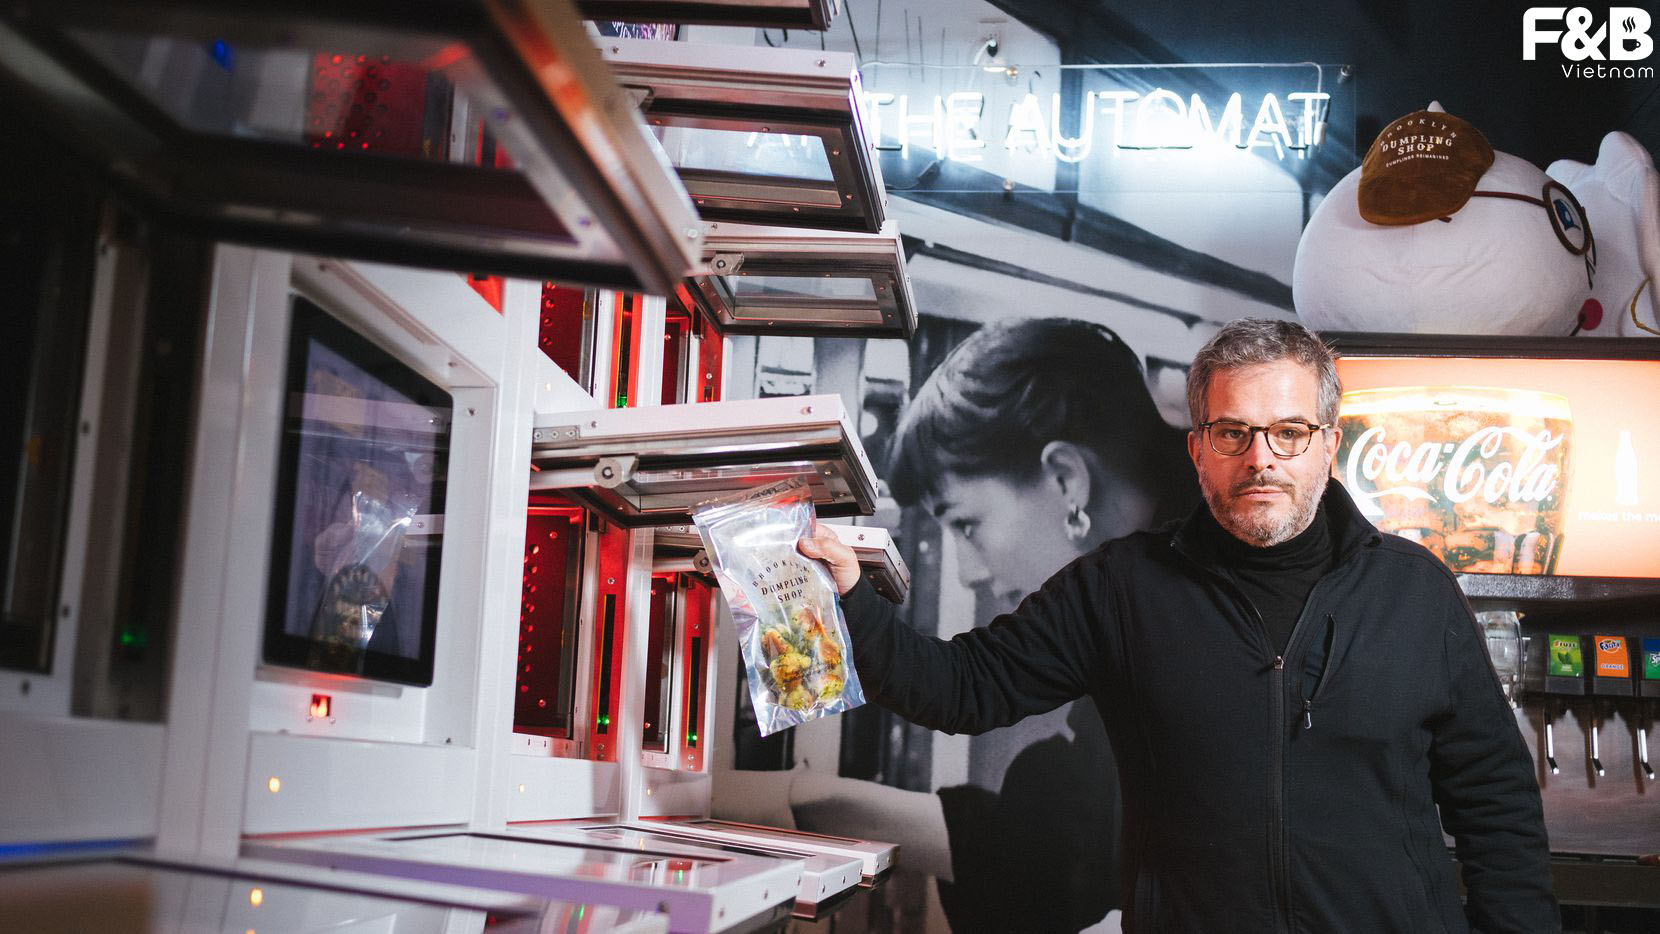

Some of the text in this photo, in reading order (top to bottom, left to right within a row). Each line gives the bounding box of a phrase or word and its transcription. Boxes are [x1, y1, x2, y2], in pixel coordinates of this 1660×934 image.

[864, 91, 985, 157] THE
[1004, 88, 1331, 158] AUTOMAT
[1382, 135, 1452, 152] DUMPLING
[1398, 143, 1434, 155] SHOP
[1347, 426, 1565, 517] Coca-Cola
[778, 588, 803, 603] SHOP
